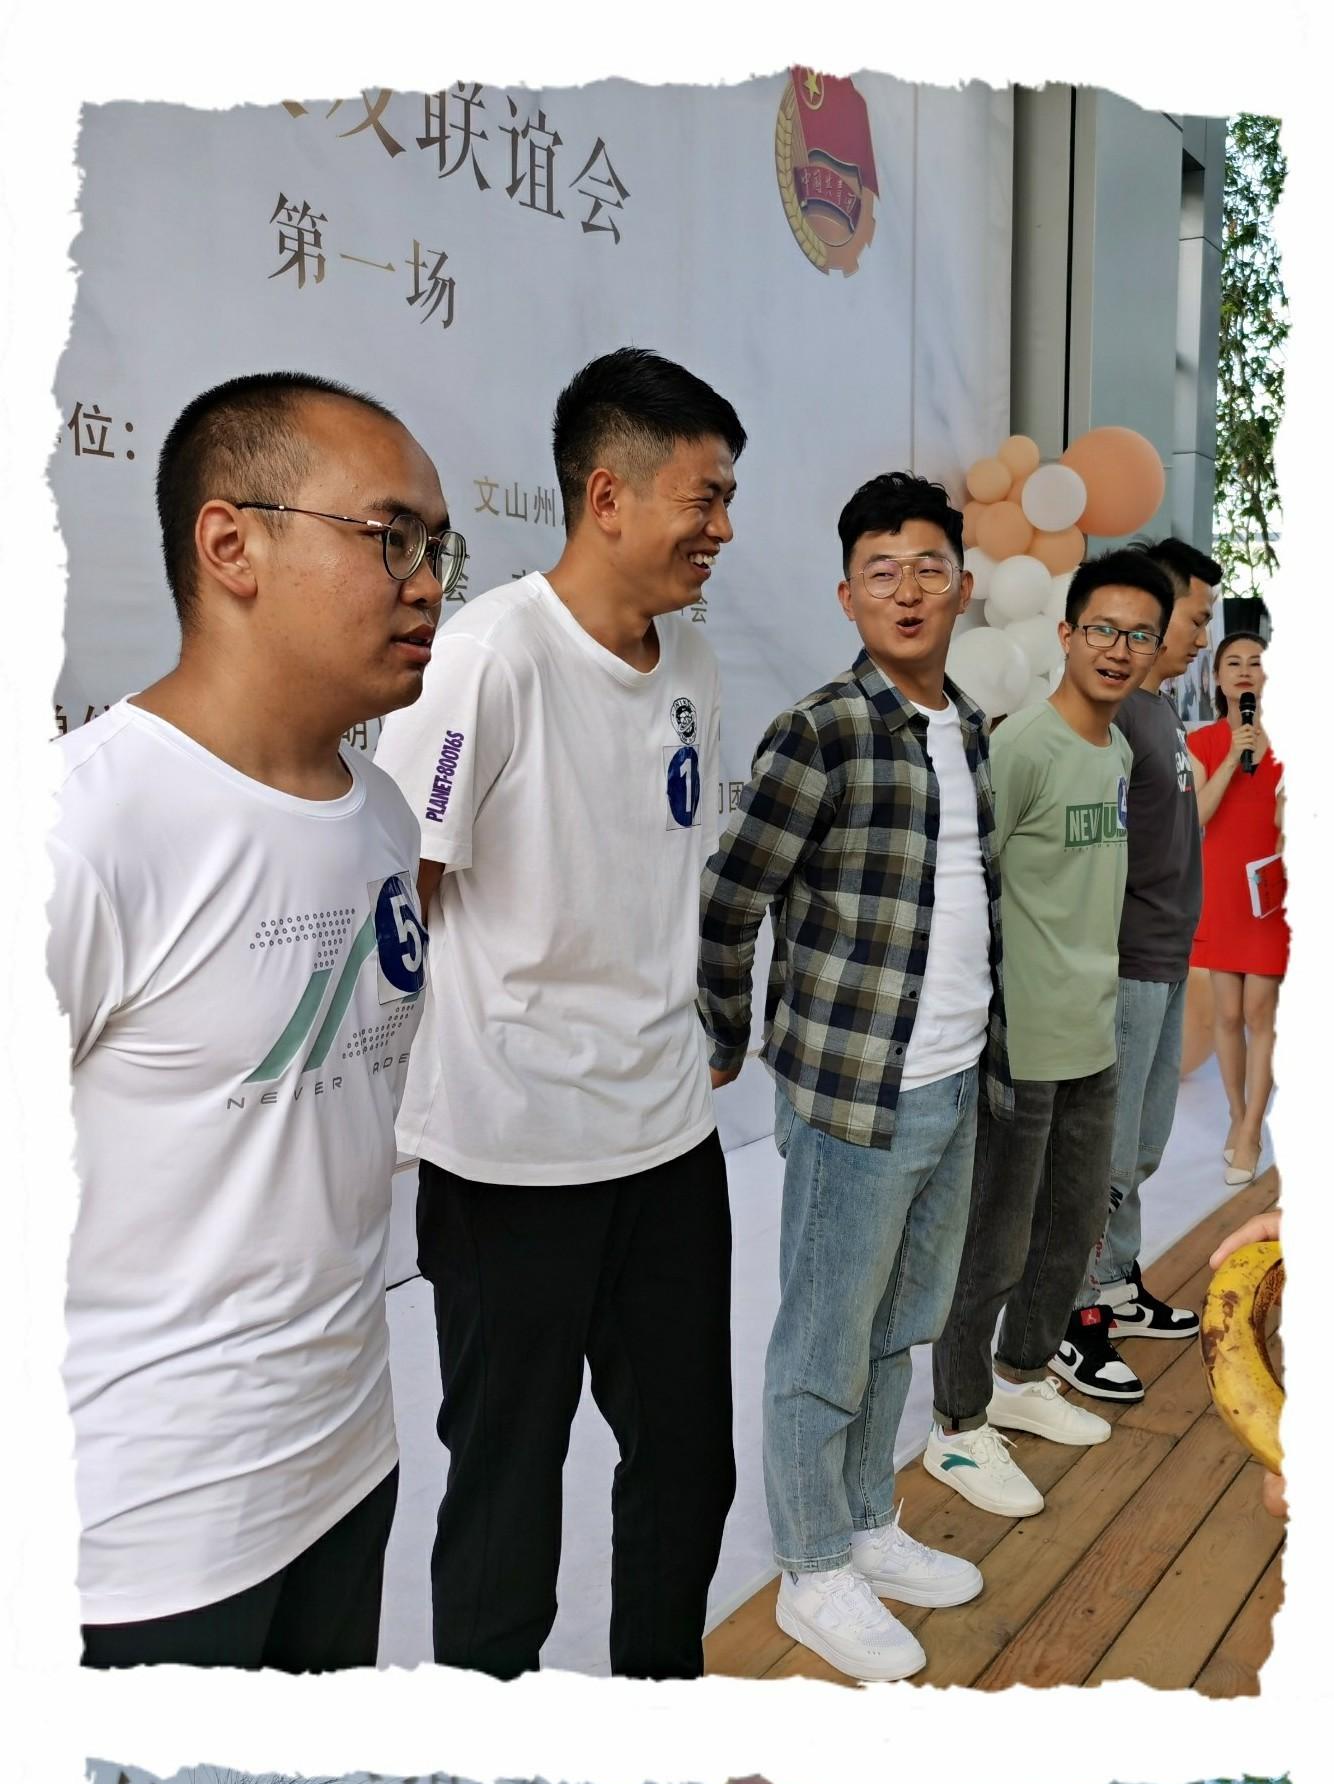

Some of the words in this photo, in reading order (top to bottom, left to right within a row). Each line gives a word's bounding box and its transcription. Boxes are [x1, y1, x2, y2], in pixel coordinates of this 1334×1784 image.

[267, 192, 456, 329] 第一场
[473, 476, 566, 527] 文山州
[389, 893, 422, 973] 5
[226, 1076, 342, 1111] NEVER
